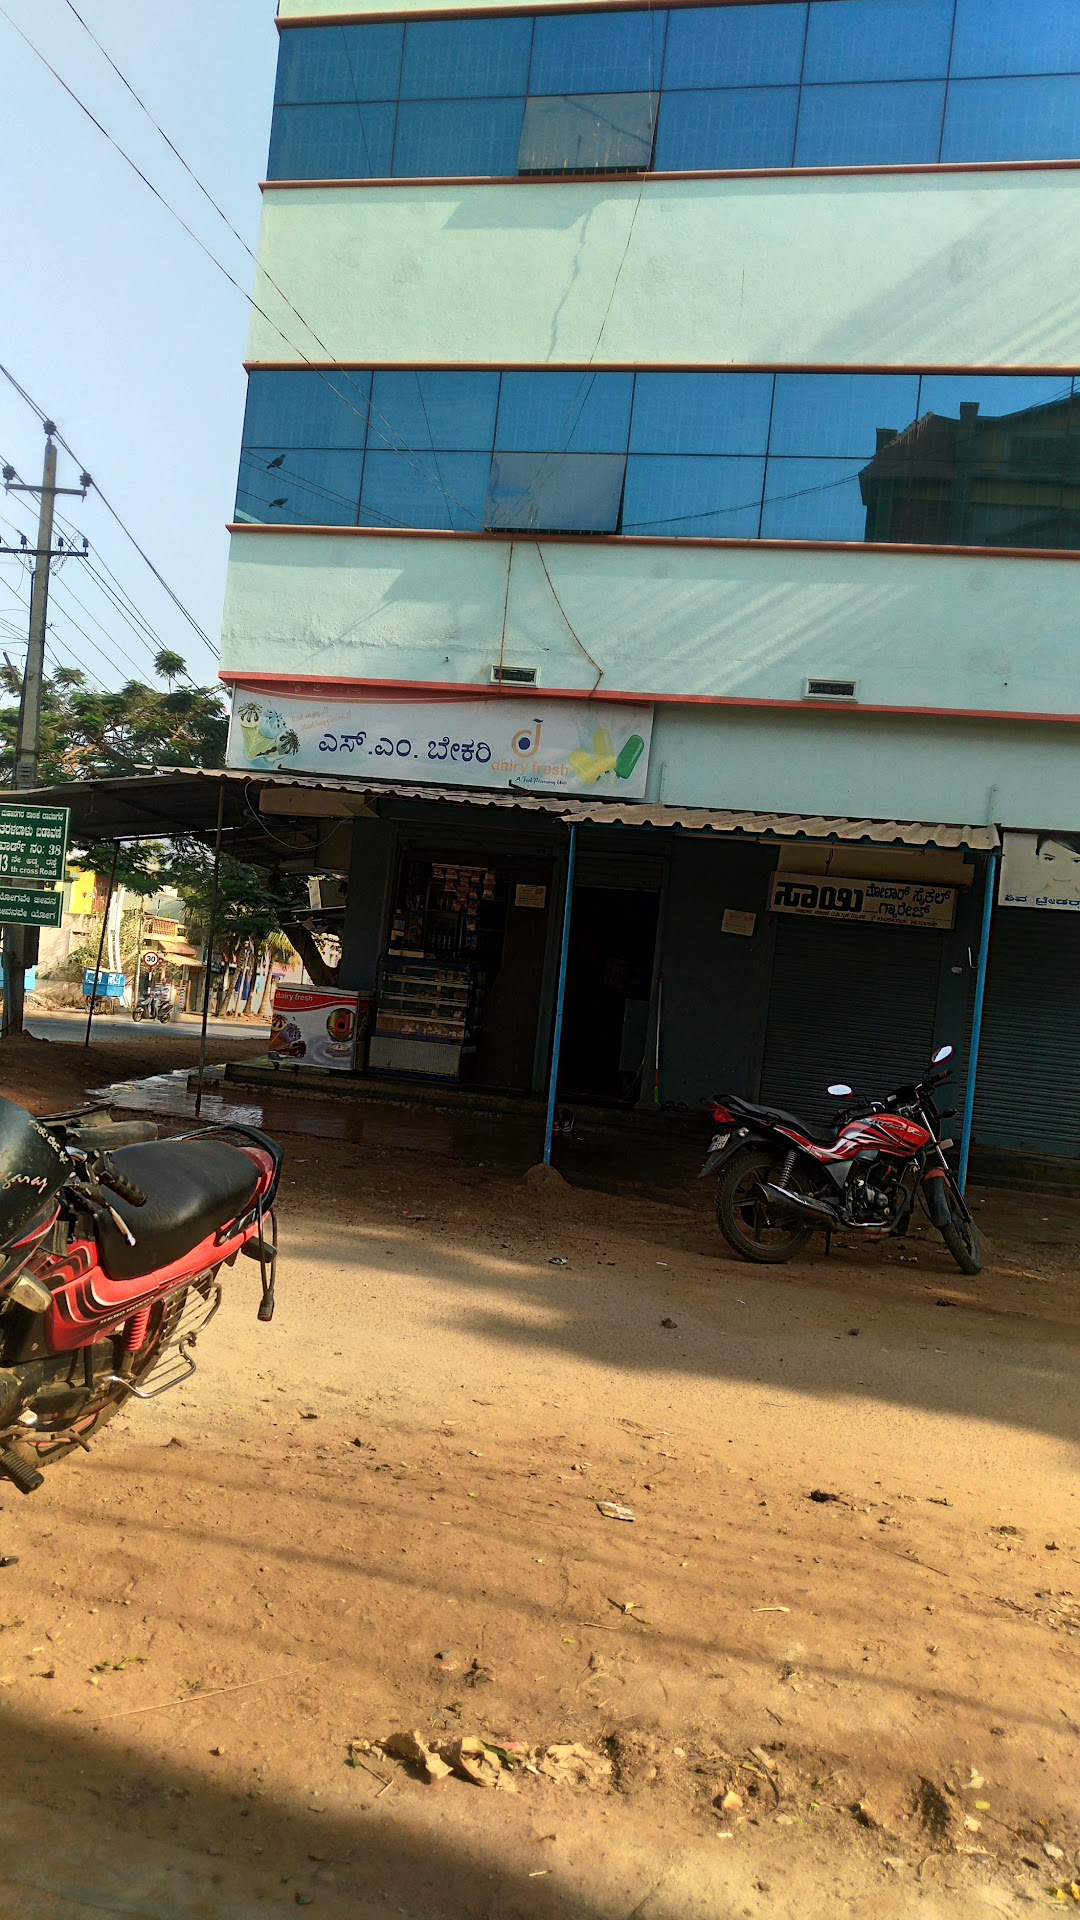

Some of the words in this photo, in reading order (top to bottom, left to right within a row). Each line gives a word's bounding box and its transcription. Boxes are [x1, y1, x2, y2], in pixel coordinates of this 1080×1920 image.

[427, 736, 492, 764] ಬೇಕರಿ
[491, 759, 528, 775] dairy
[532, 761, 569, 777] fresh
[36, 826, 62, 839] ಬಡಾವಣೆ
[48, 844, 62, 856] 38
[19, 867, 38, 875] cross
[39, 867, 57, 876] Road
[774, 881, 864, 912] ಸಾಯಿ
[912, 887, 951, 906] ಸೈಕಲ್
[31, 910, 56, 920] ಯೋಗ
[146, 955, 156, 963] 30
[276, 992, 294, 1001] dairy
[295, 993, 313, 1001] fresh
